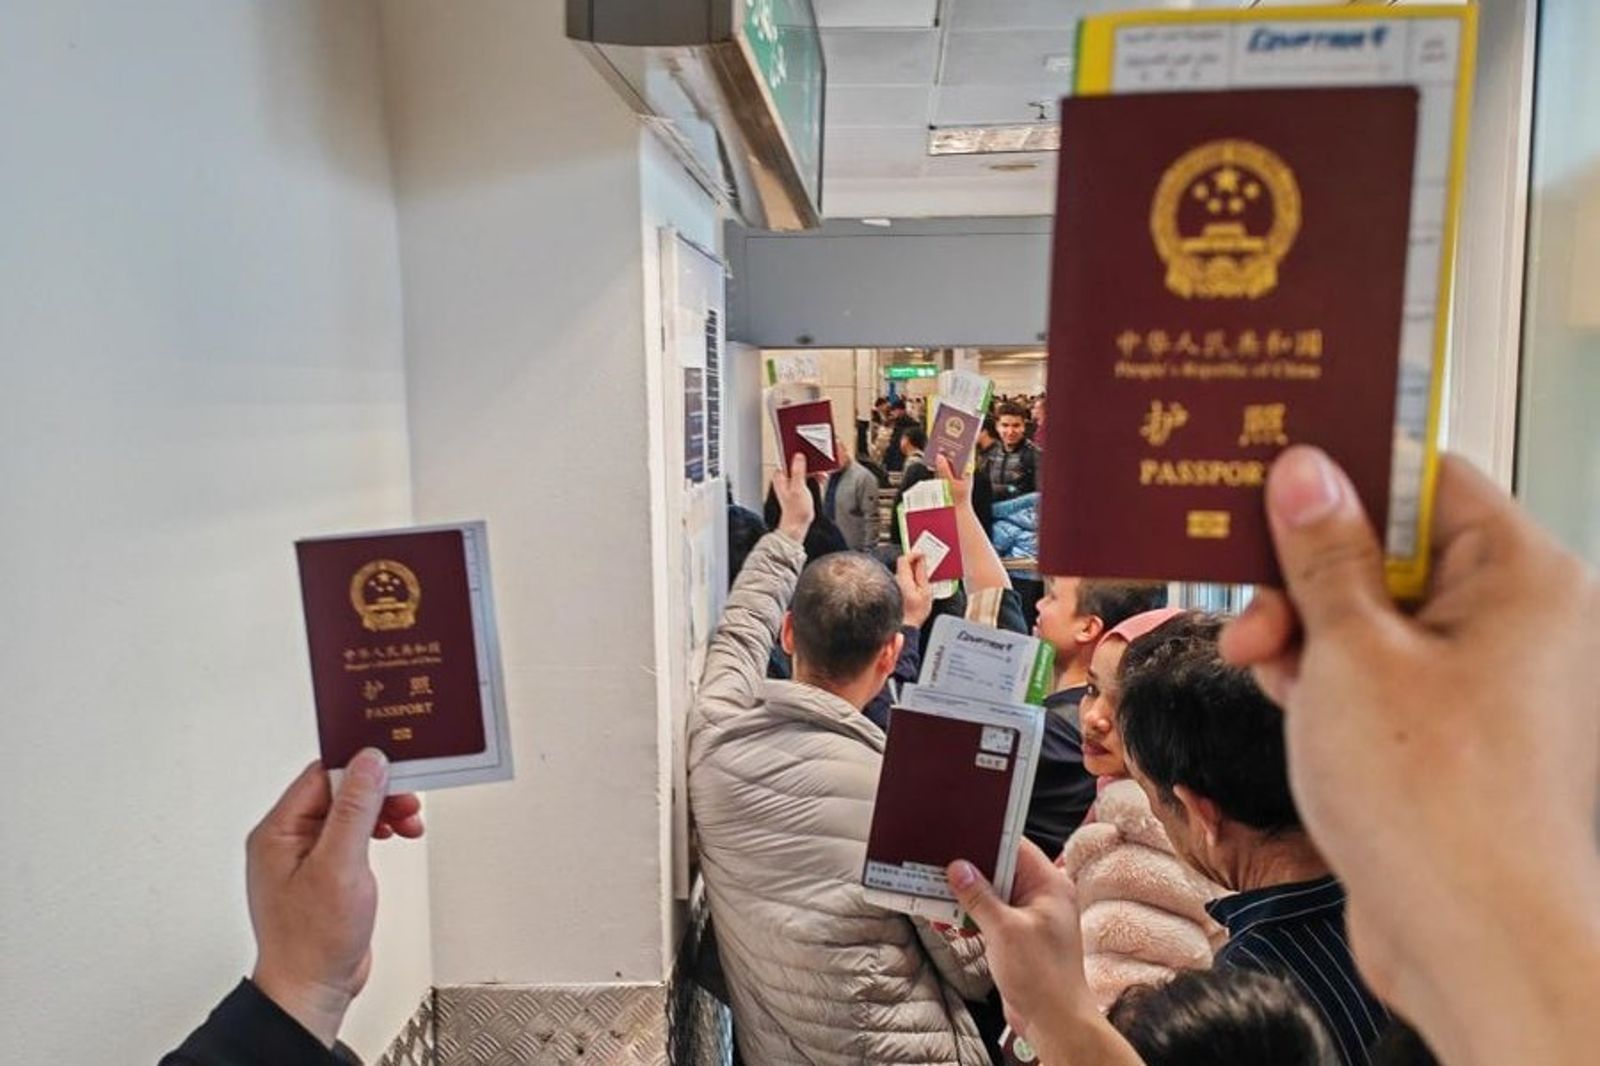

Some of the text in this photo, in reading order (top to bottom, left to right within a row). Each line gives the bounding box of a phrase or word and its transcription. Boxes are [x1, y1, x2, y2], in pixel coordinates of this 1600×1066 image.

[1115, 328, 1323, 360] 中华人民共和国
[1140, 400, 1288, 446] 护 照
[1139, 459, 1265, 487] PASSPOR
[365, 701, 435, 720] PASSPORT
